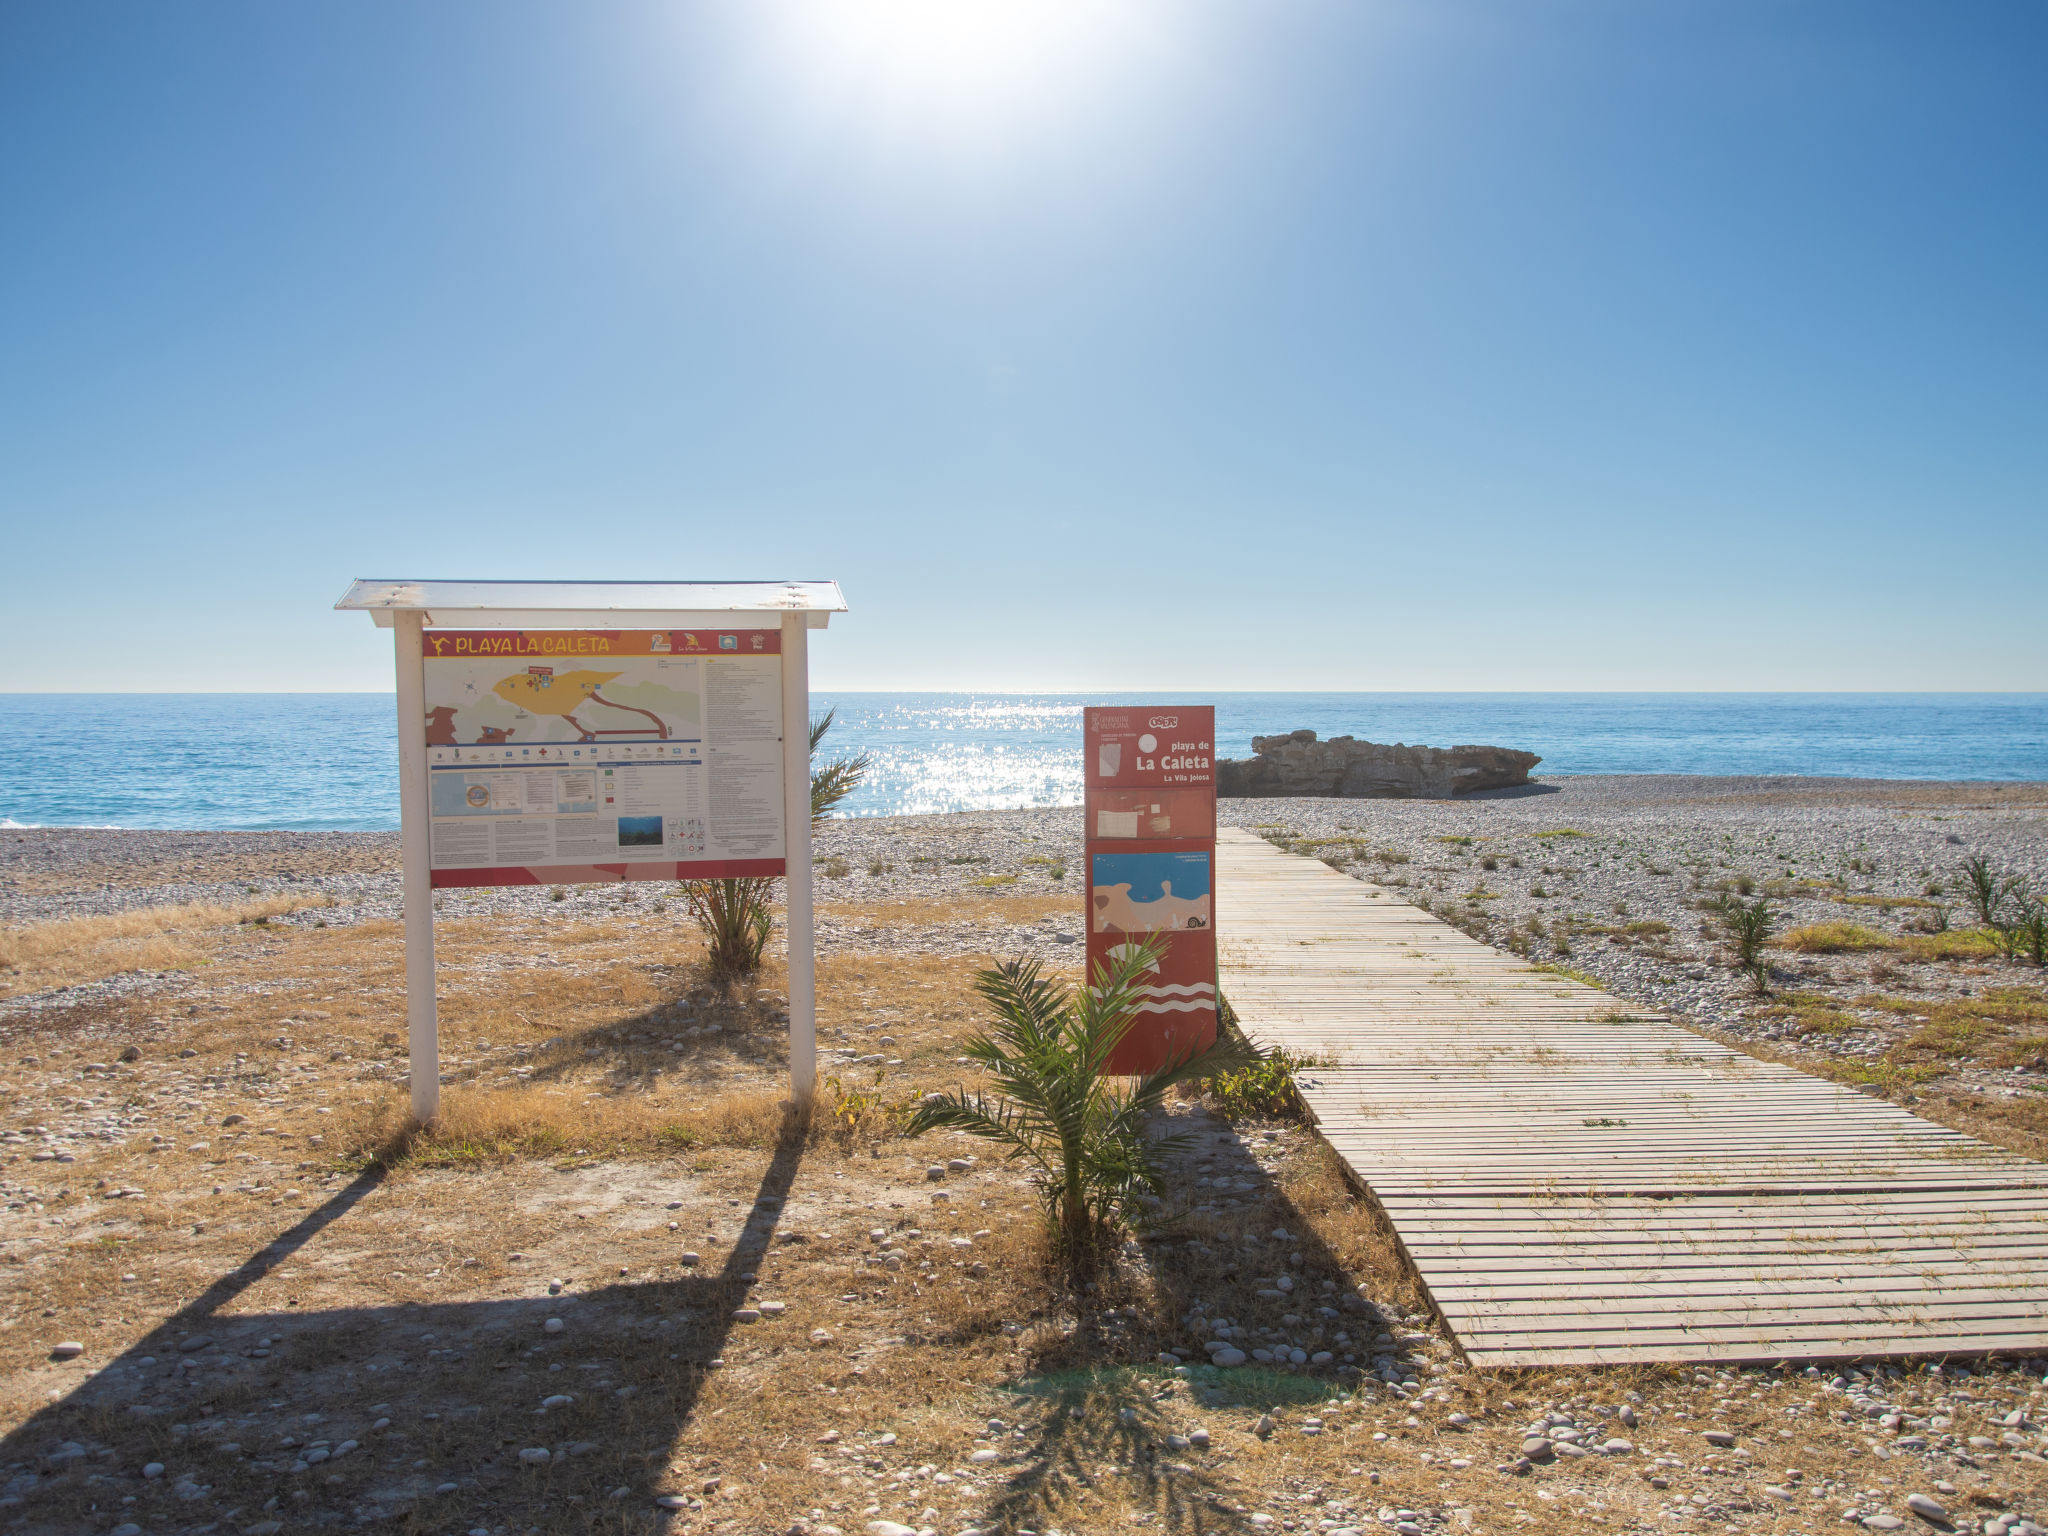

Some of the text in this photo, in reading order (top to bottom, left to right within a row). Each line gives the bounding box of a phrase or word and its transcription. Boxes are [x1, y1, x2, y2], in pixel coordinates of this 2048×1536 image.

[456, 637, 609, 654] PLAYA LA CALETA
[1171, 741, 1209, 753] playa de
[1136, 755, 1209, 771] La Caleta
